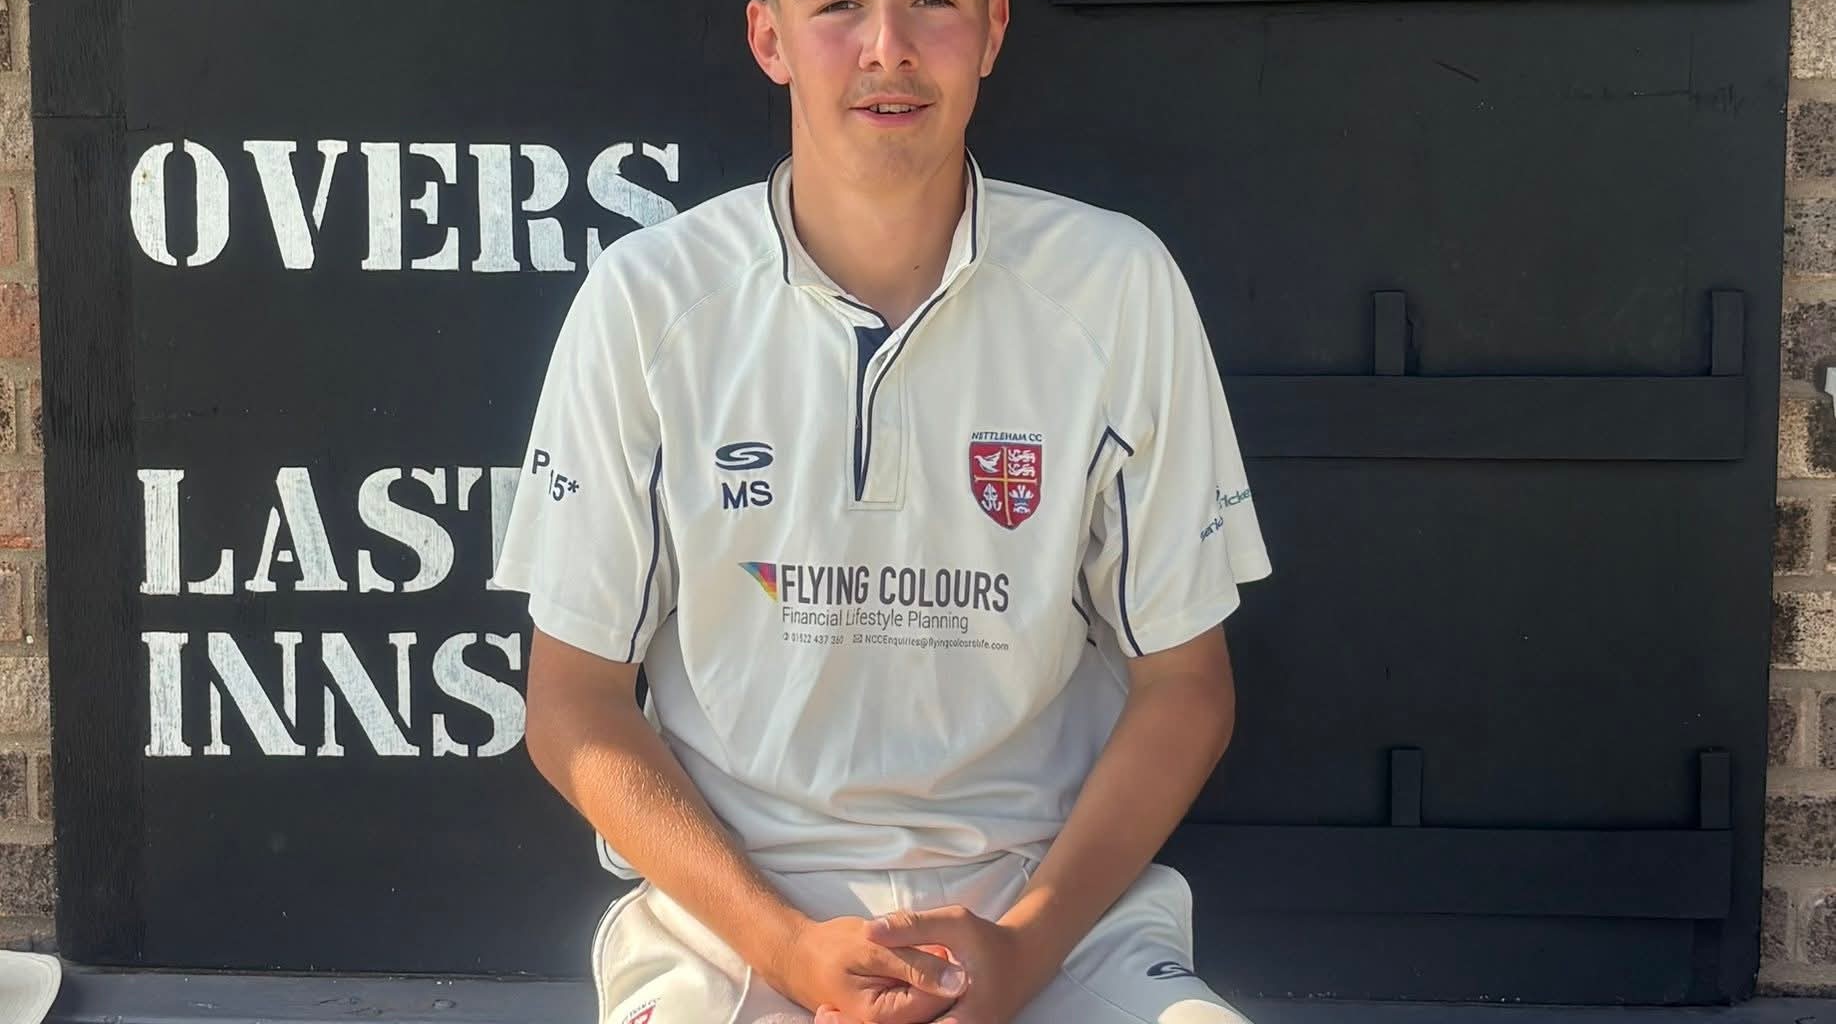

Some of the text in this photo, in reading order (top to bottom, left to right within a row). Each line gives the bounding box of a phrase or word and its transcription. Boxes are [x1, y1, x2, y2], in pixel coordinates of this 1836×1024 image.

[1028, 433, 1043, 443] CC
[722, 480, 773, 510] MS
[781, 564, 1010, 613] FLYING COLOURS
[782, 606, 969, 634] Financial Lifestyle Planning
[141, 632, 527, 757] INNS
